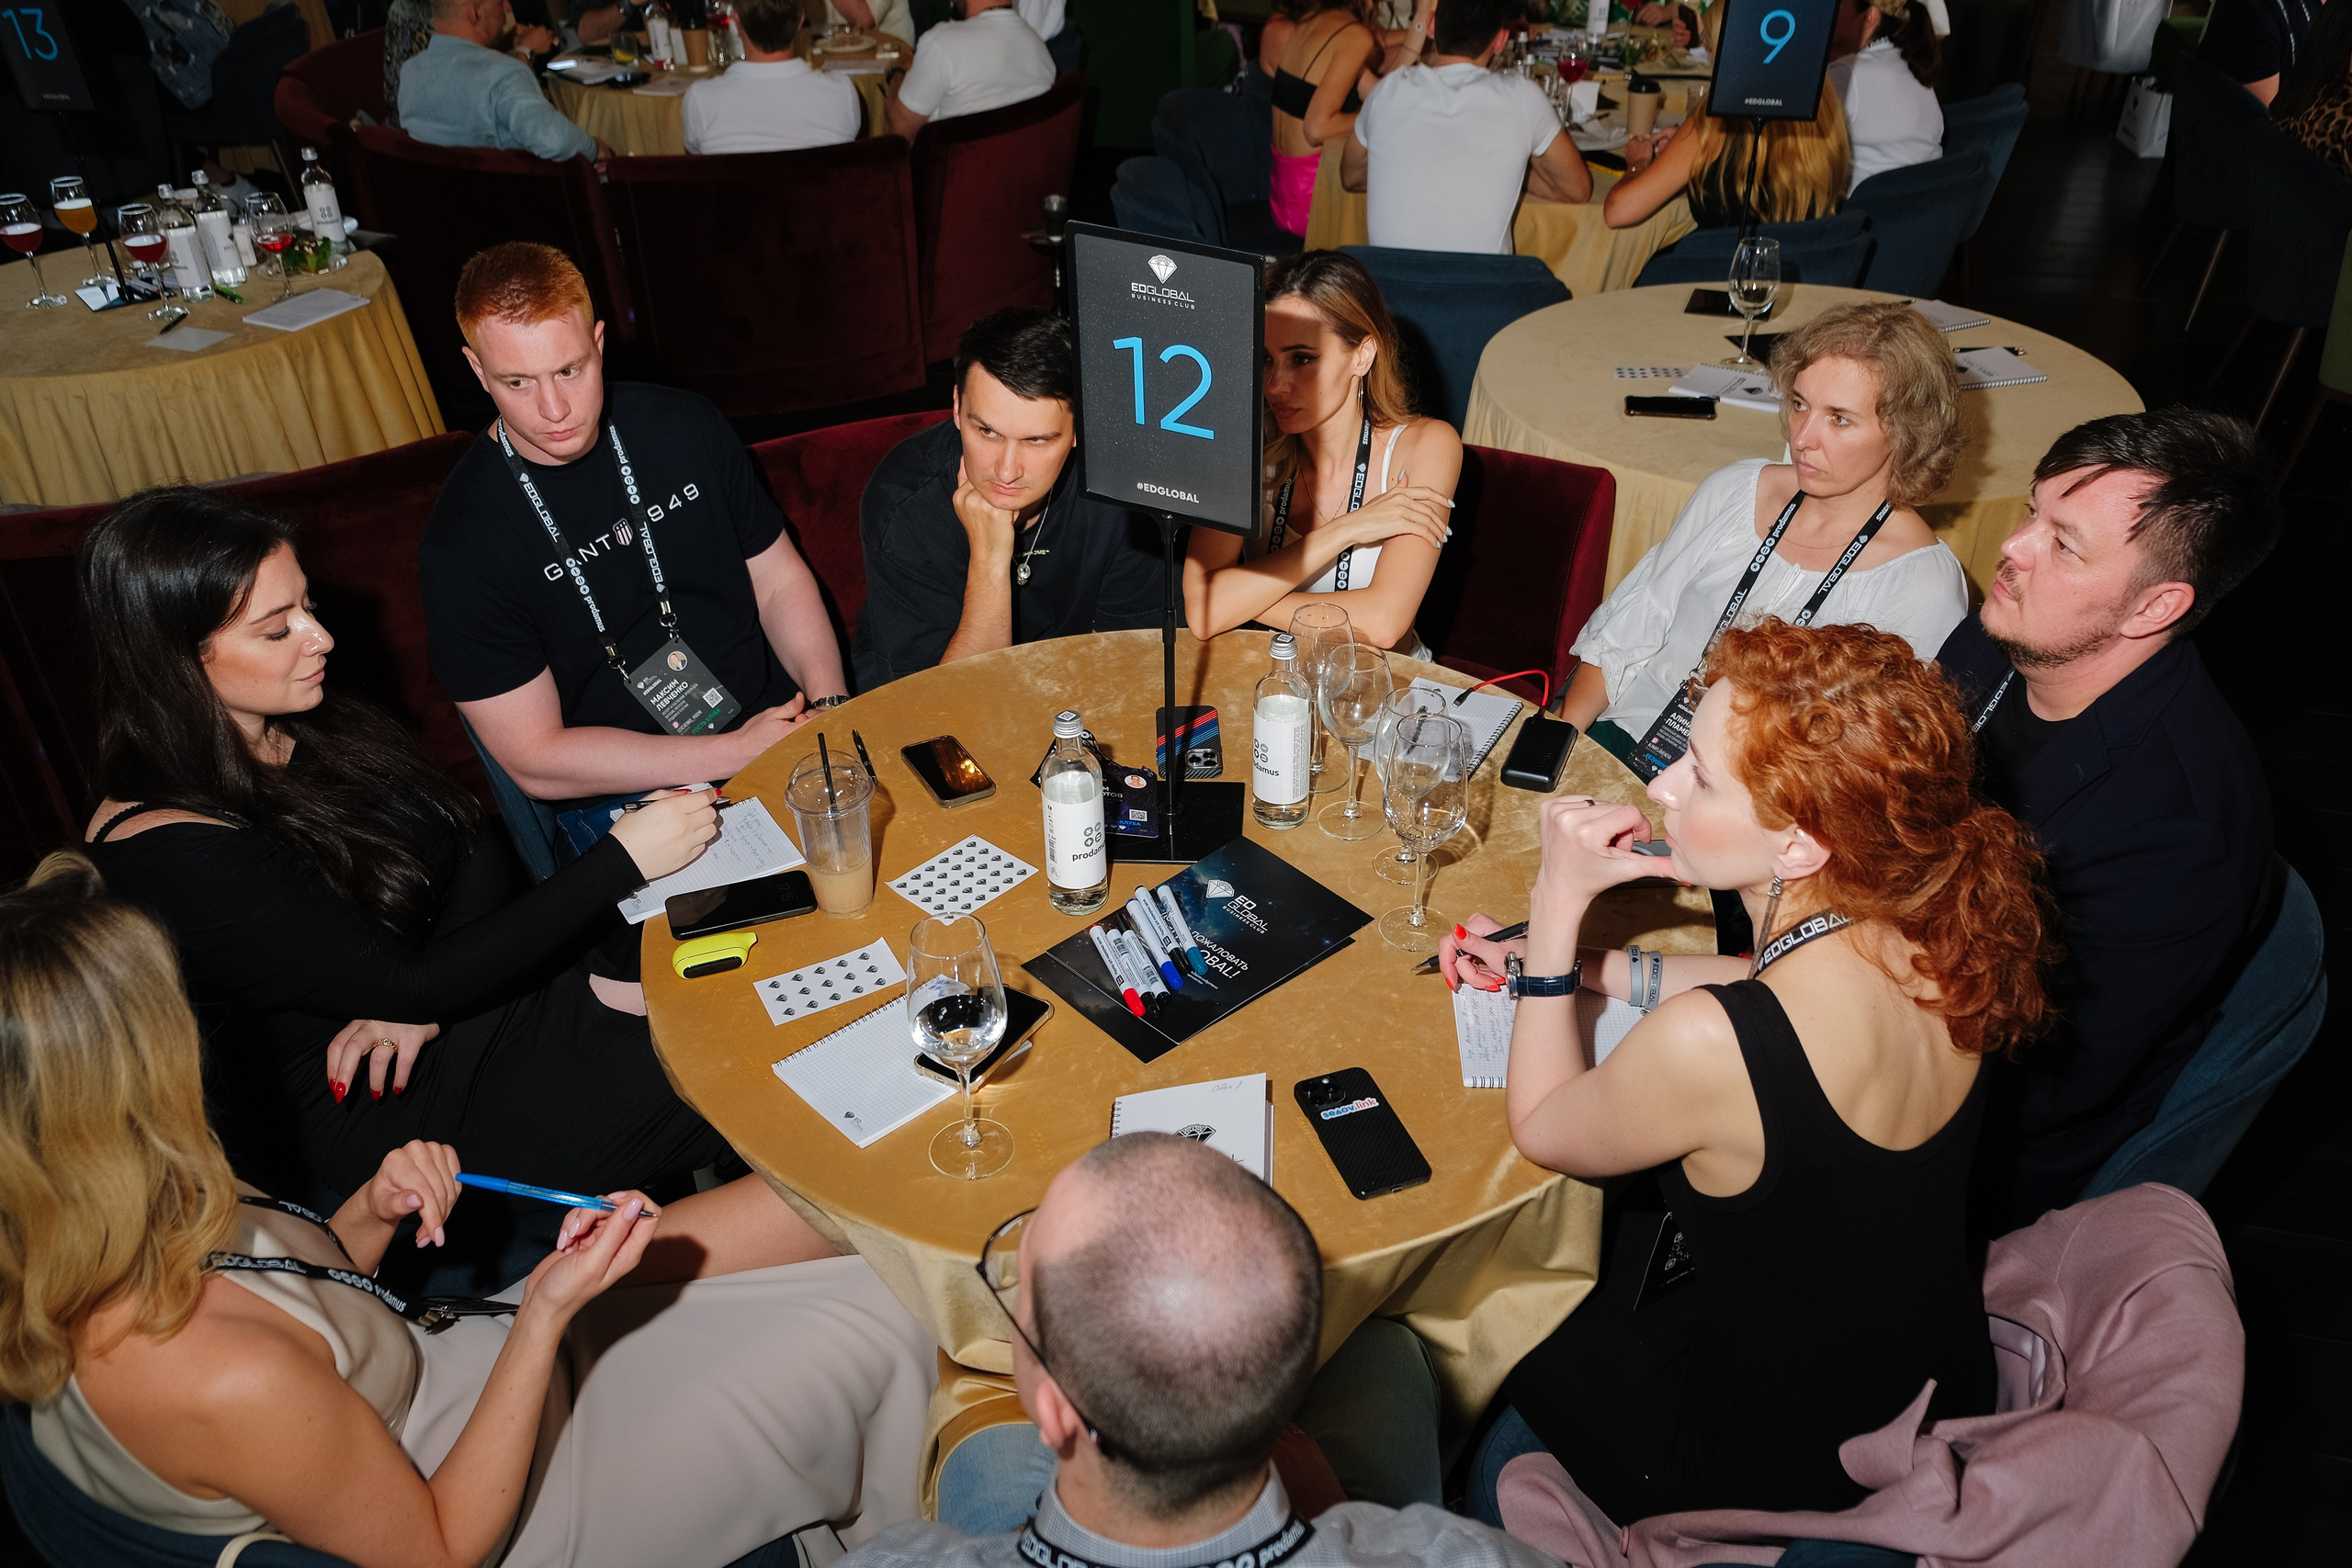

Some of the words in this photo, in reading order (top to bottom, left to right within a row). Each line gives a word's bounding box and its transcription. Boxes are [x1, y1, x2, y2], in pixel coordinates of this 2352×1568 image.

[2, 8, 59, 61] 13
[1759, 8, 1796, 65] 9
[1745, 97, 1782, 107] #EDGLOBAL
[1131, 293, 1171, 306] BUSINESS
[1174, 301, 1194, 310] CLUB
[1113, 336, 1215, 440] 12
[609, 425, 628, 465] prodamus
[1136, 481, 1200, 504] #EDGLOBAL
[523, 481, 560, 543] EDGLOBAL
[1772, 503, 1796, 538] prodamus
[544, 534, 611, 581] GNT
[646, 483, 700, 523] 949
[639, 522, 663, 583] EDGLOBAL
[1818, 541, 1862, 594] EDGLOBAL
[584, 595, 606, 633] prodamus
[650, 679, 680, 705] МАКСИМ
[656, 682, 689, 712] ЛЕВЧЕНКО
[1223, 906, 1250, 925] BUSINESS
[1250, 923, 1265, 934] CLUB
[1227, 901, 1268, 931] GLOBAL
[1235, 895, 1257, 910] ED
[1192, 931, 1248, 970] ПОЖАЛОВАТЬ
